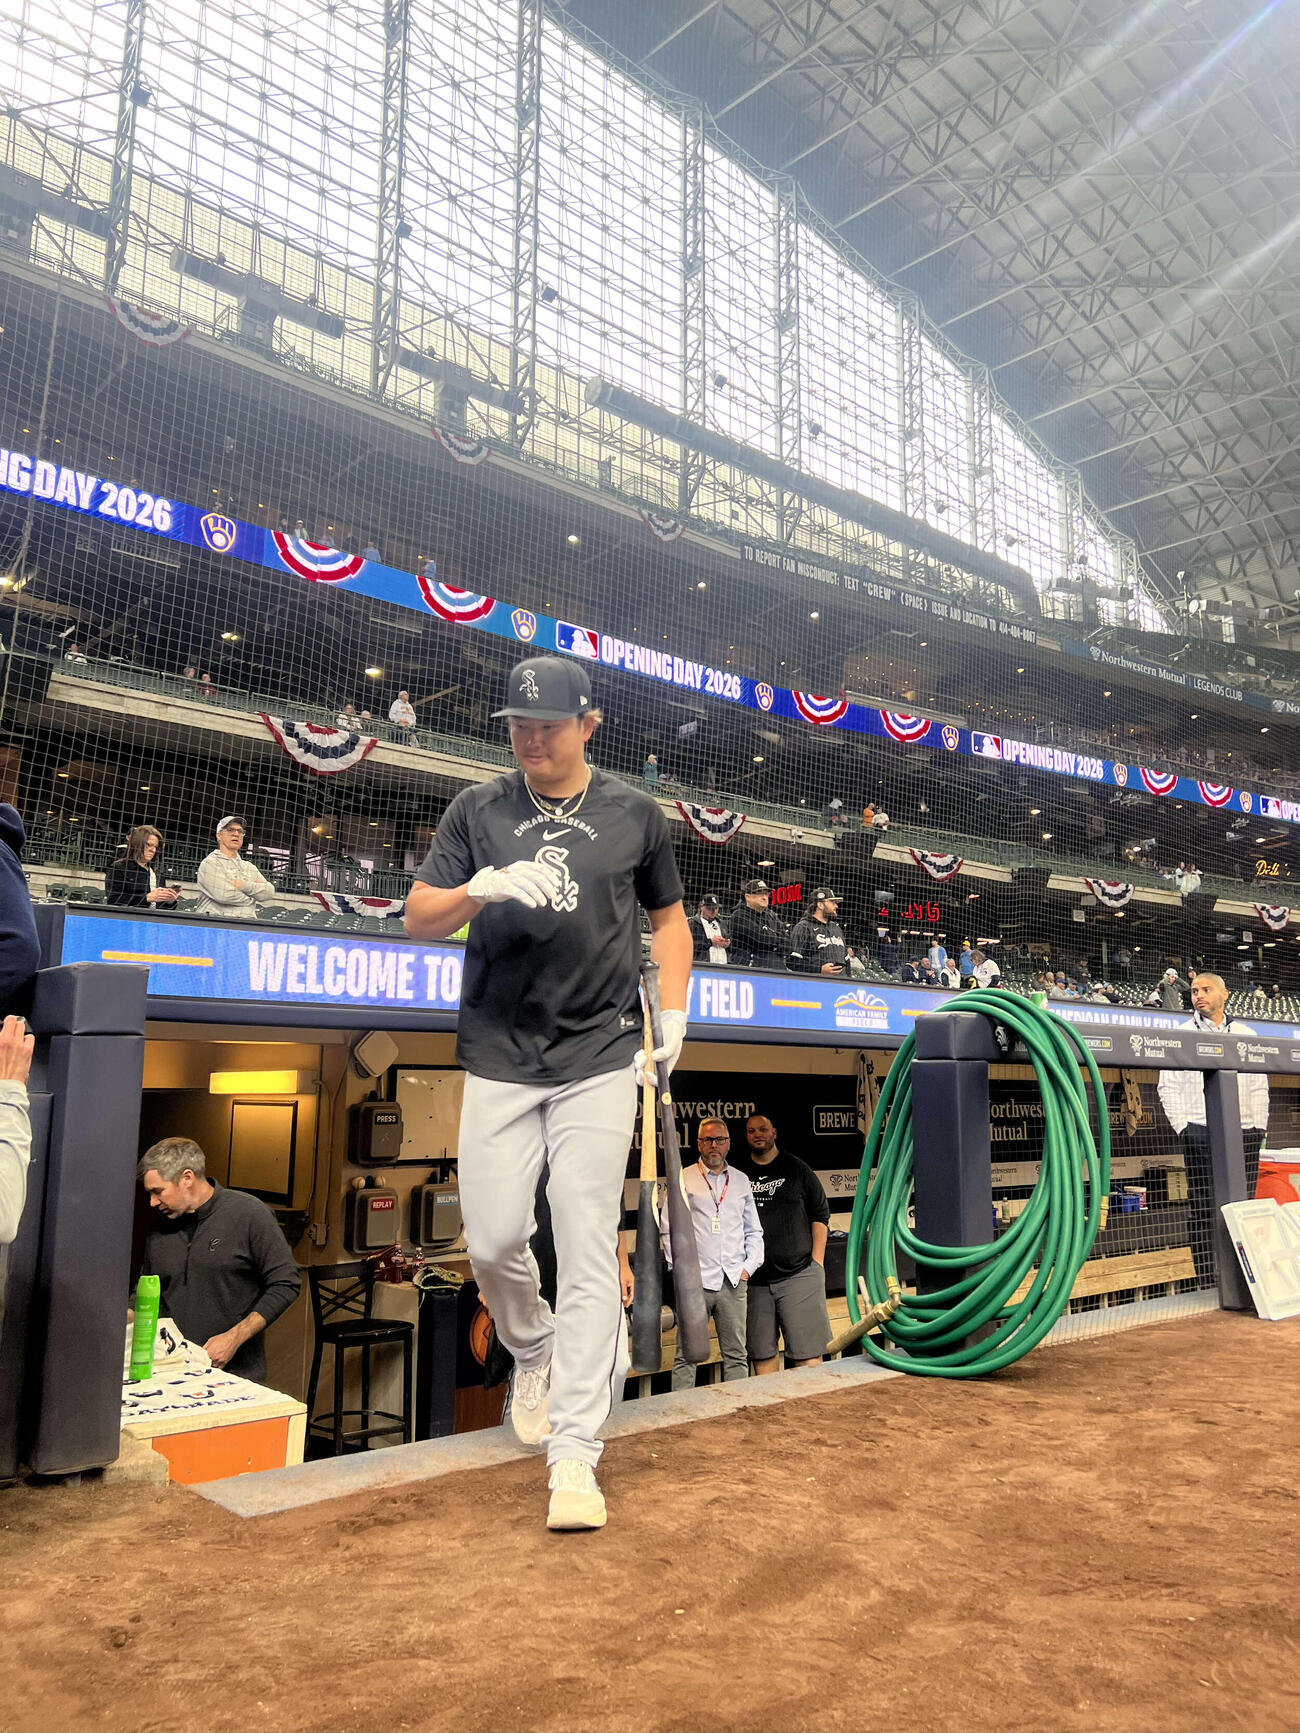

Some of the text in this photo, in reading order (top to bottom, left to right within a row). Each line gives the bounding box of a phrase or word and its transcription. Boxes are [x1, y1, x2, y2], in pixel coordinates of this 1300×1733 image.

[33, 461, 101, 510] DAY
[98, 481, 172, 531] 2026
[744, 546, 753, 561] TO
[755, 549, 780, 569] REPORT
[782, 557, 796, 574] FAN
[844, 575, 860, 592] TEXT
[932, 601, 948, 617] ISSUE
[949, 607, 961, 621] AND
[962, 610, 988, 630] LOCATION
[989, 618, 997, 632] TO
[601, 635, 741, 700] OPENING DAY 2026
[1101, 650, 1243, 701] Northwestern Mutual LEGENDS CLUB
[1002, 738, 1104, 780] OPENING DAY 2026
[247, 940, 461, 1003] WELCOME TO
[700, 977, 754, 1019] FIELD
[1144, 1036, 1182, 1048] Northwestern
[1144, 1048, 1166, 1058] Mutual
[376, 1114, 397, 1123] PRESS
[372, 1200, 393, 1209] REPLAY
[750, 1178, 786, 1196] hicago
